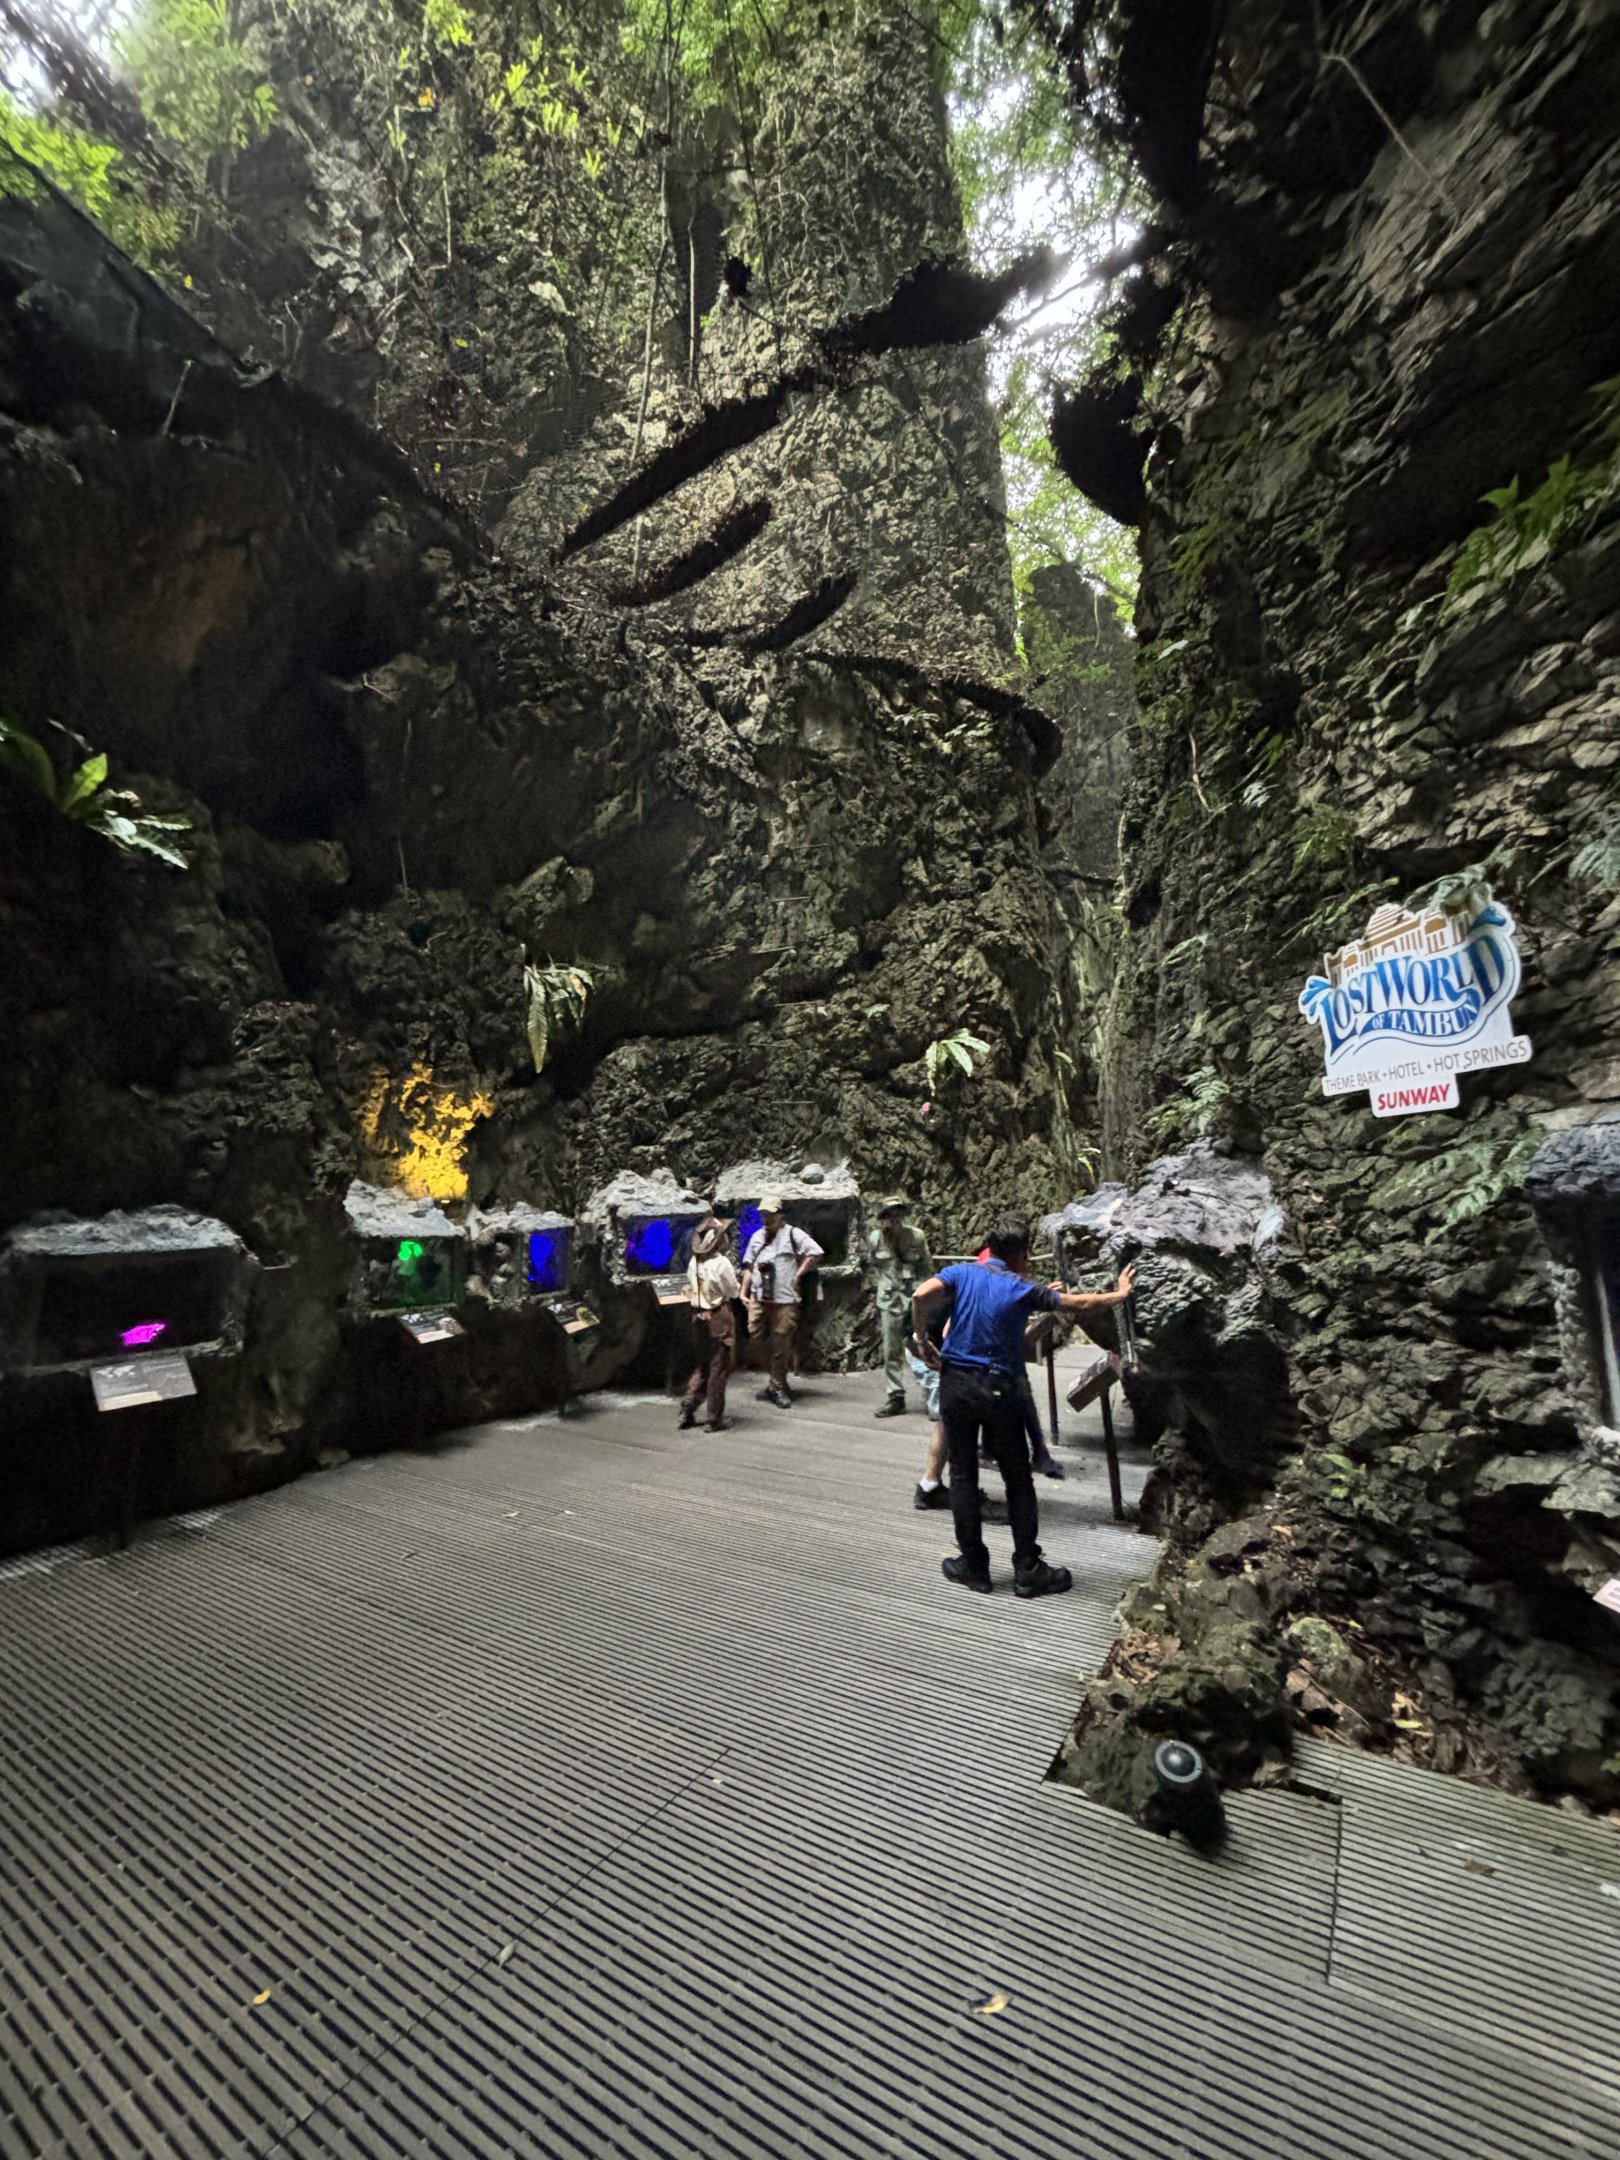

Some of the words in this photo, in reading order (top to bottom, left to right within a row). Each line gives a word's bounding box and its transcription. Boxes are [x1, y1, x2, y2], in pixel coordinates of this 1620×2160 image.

[1320, 971, 1378, 1056] LOST
[1374, 935, 1505, 1012] WORLD
[1371, 1013, 1388, 1030] OF
[1391, 1002, 1480, 1037] TAMBUN
[1325, 1074, 1356, 1093] THEME
[1357, 1070, 1382, 1088] PARK
[1388, 1061, 1424, 1081] HOTEL
[1434, 1053, 1462, 1073] HOT
[1463, 1040, 1529, 1070] SPRINGS
[1378, 1083, 1451, 1111] SUNWAY
